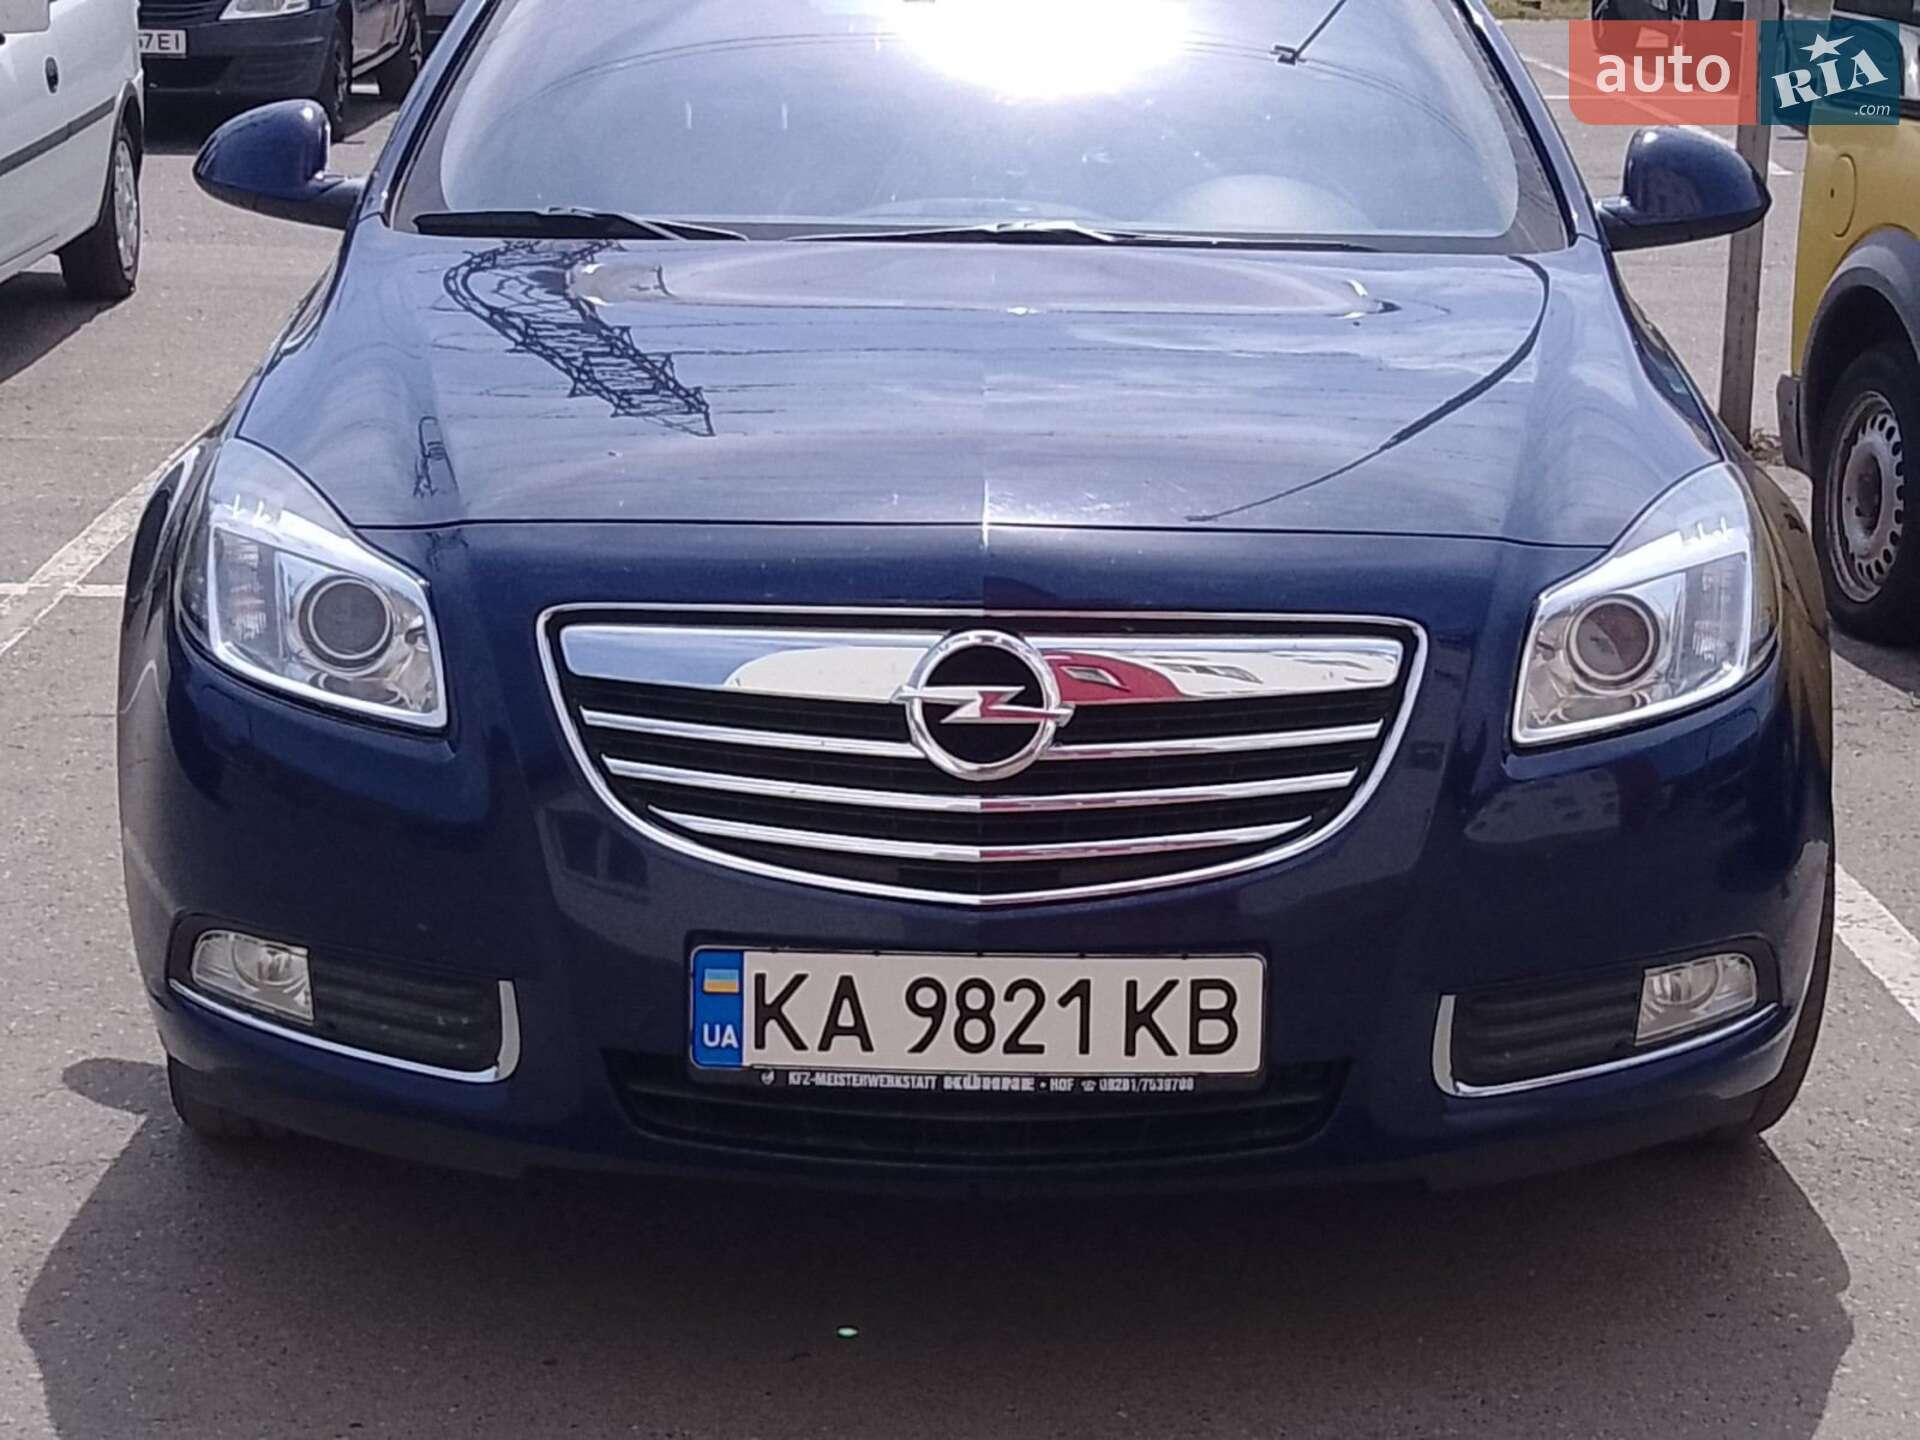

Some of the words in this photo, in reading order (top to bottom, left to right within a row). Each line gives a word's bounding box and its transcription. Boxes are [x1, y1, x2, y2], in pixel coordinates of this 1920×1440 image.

[702, 1023, 740, 1050] UA
[753, 972, 876, 1053] KA
[903, 976, 1092, 1056] 9821
[1122, 977, 1240, 1058] KB
